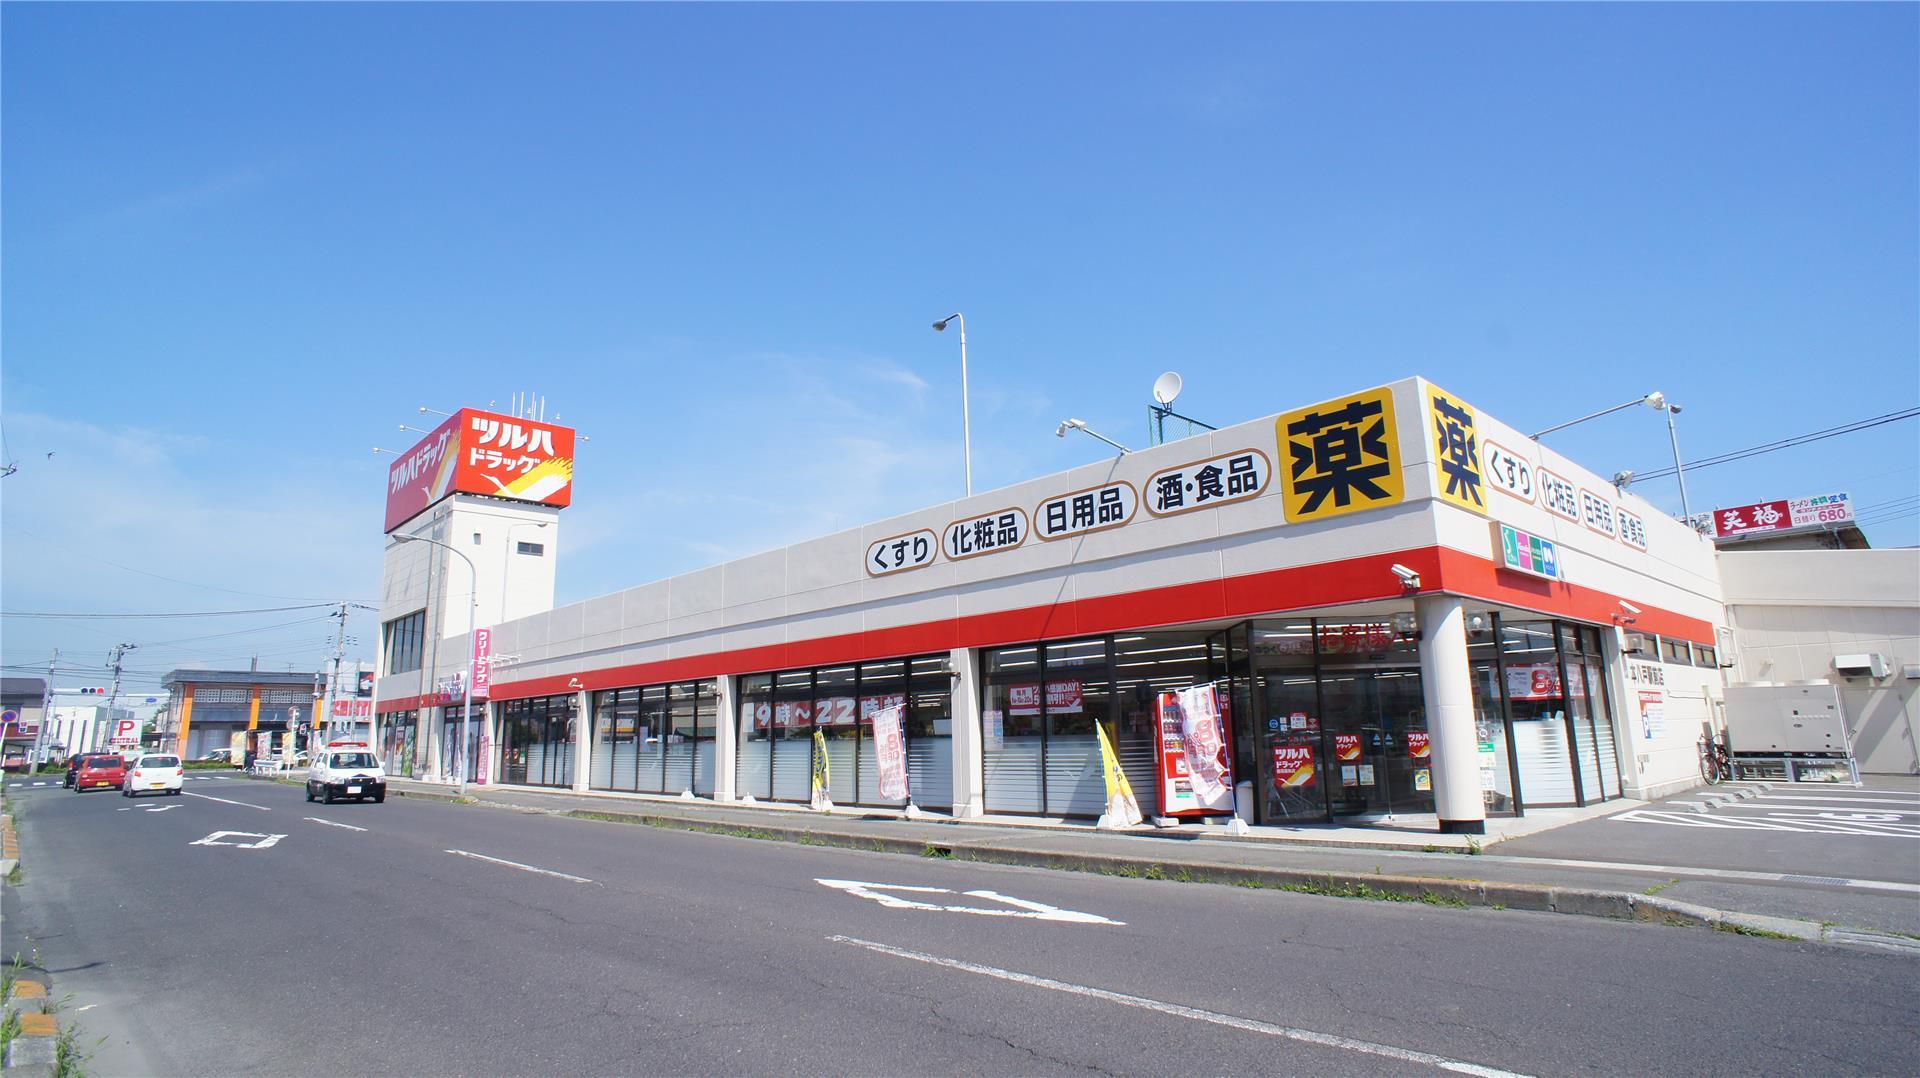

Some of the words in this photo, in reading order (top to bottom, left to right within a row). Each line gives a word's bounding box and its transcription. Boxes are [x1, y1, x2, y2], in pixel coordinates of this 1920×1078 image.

[471, 417, 555, 456] ツルハ
[1433, 397, 1483, 507] 薬
[391, 428, 451, 494] ツルハドラッグ
[469, 447, 541, 474] ドラッグ
[1287, 400, 1392, 515] 薬
[1491, 450, 1530, 495] くすり
[1156, 455, 1258, 510] 酒・食品
[1542, 473, 1577, 517] 化粧品
[1047, 487, 1123, 534] 日用品
[1583, 494, 1613, 533] 日用品
[874, 536, 928, 569] くすり
[952, 513, 1018, 555] 化粧品
[1531, 669, 1561, 694] 8%
[118, 720, 135, 736] P
[1335, 735, 1357, 743] ツルハ
[1275, 748, 1310, 759] ツルハ
[1276, 761, 1302, 769] ドラッグ
